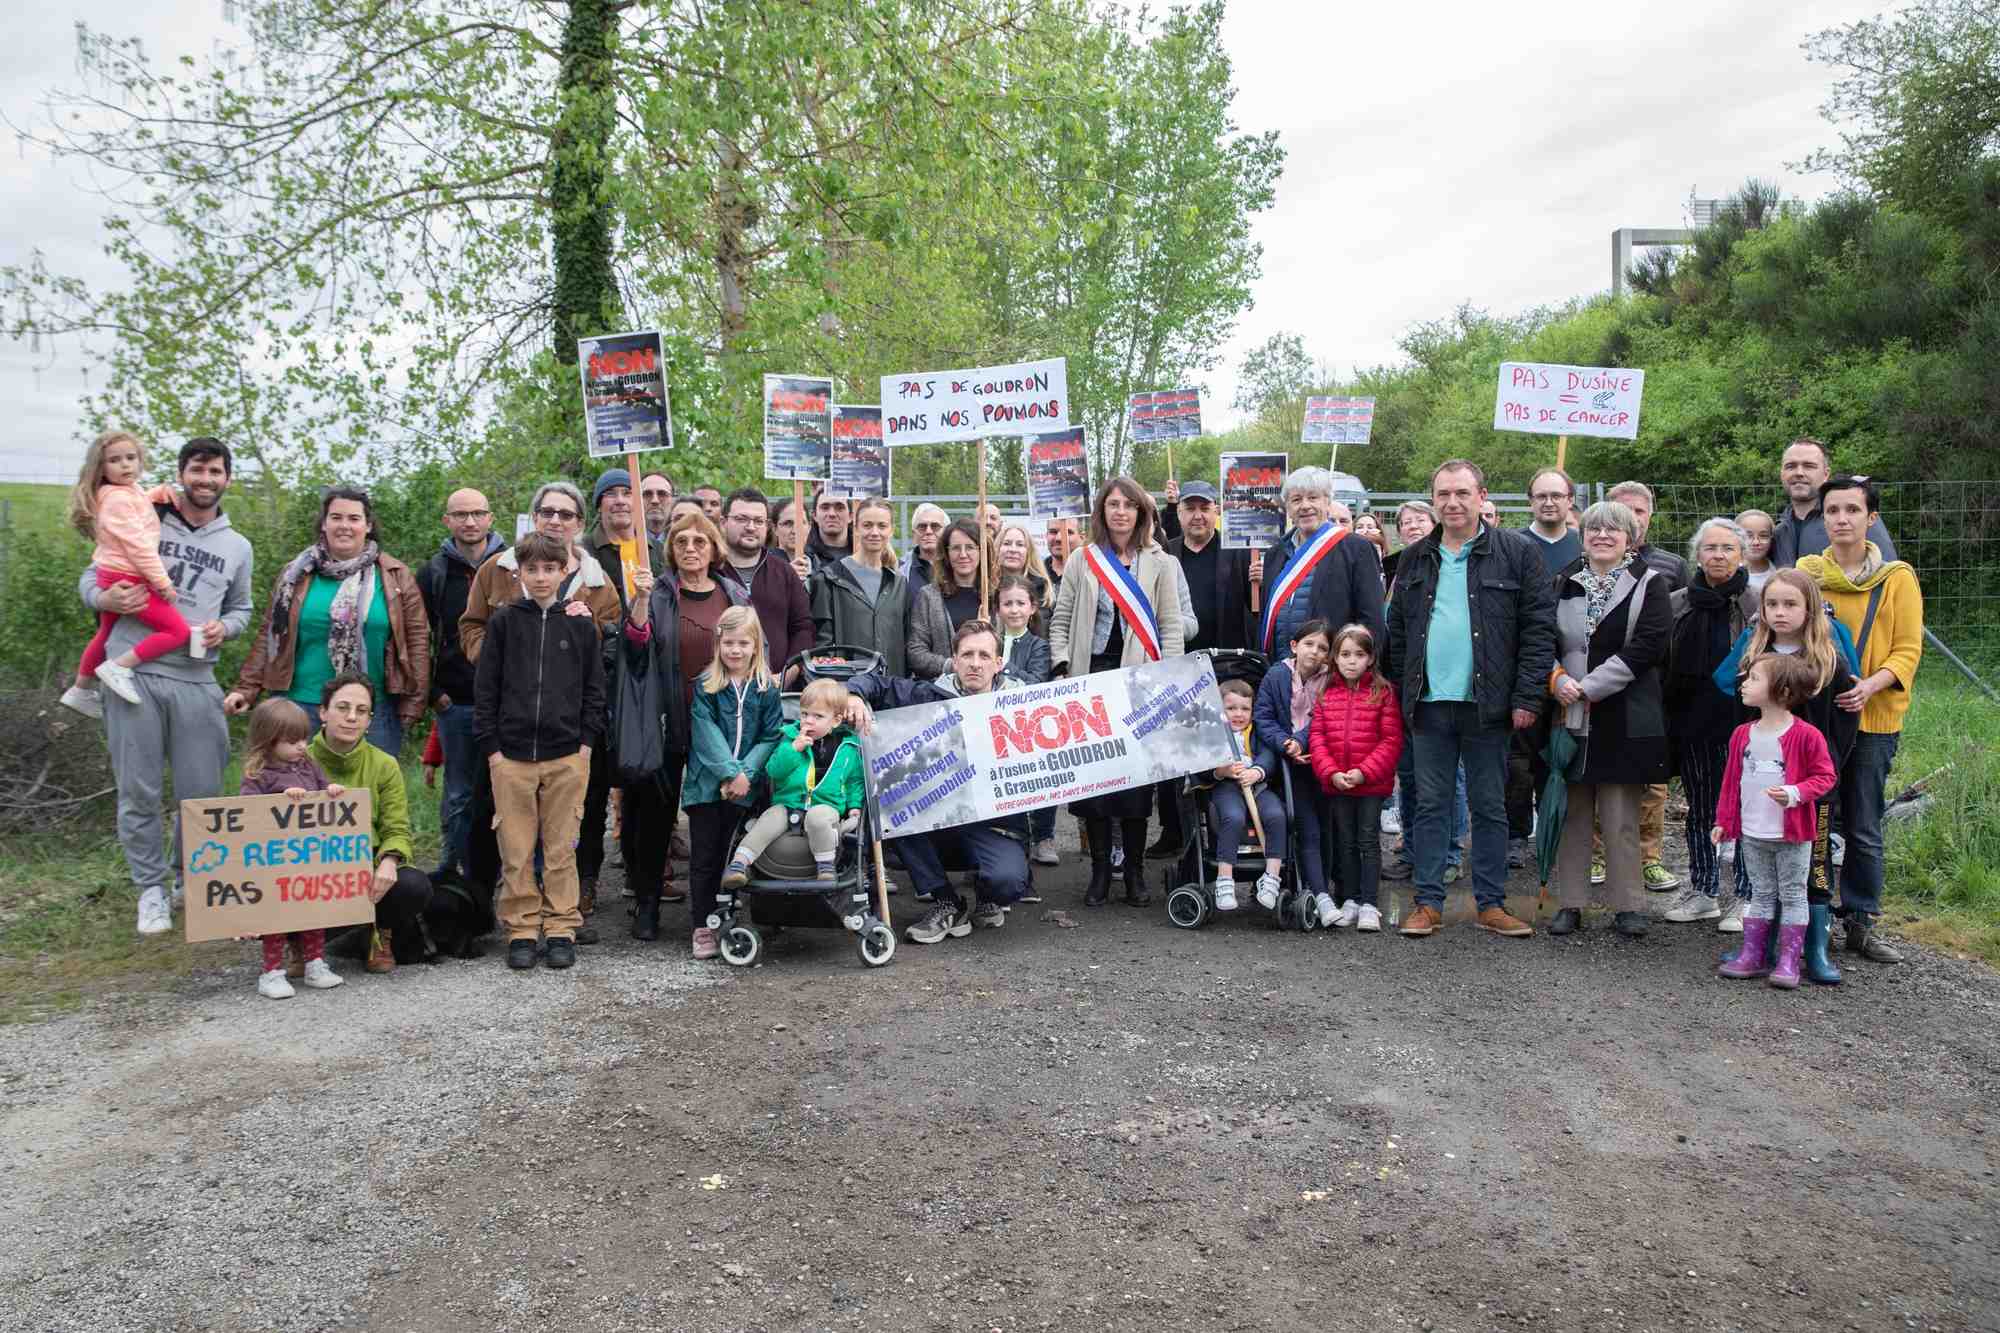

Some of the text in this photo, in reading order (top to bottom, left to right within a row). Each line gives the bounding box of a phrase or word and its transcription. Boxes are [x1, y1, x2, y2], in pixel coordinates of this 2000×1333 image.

[588, 346, 655, 378] NON
[899, 372, 1048, 399] PAS DE GOUDRON
[1512, 367, 1550, 389] PAS
[887, 399, 1058, 433] DANS NOS POUMONS
[1503, 402, 1630, 425] PAS DE CANCER
[1228, 467, 1281, 489] NON
[168, 561, 204, 591] 47
[1054, 682, 1079, 698] NOUS
[989, 695, 1112, 759] NON
[999, 761, 1037, 779] l'usine
[1046, 738, 1127, 771] GOUDRON
[994, 771, 1076, 798] à Gragnague
[203, 802, 358, 833] JE VEUX
[891, 810, 908, 828] de
[207, 870, 371, 907] PAS TOUSSER
